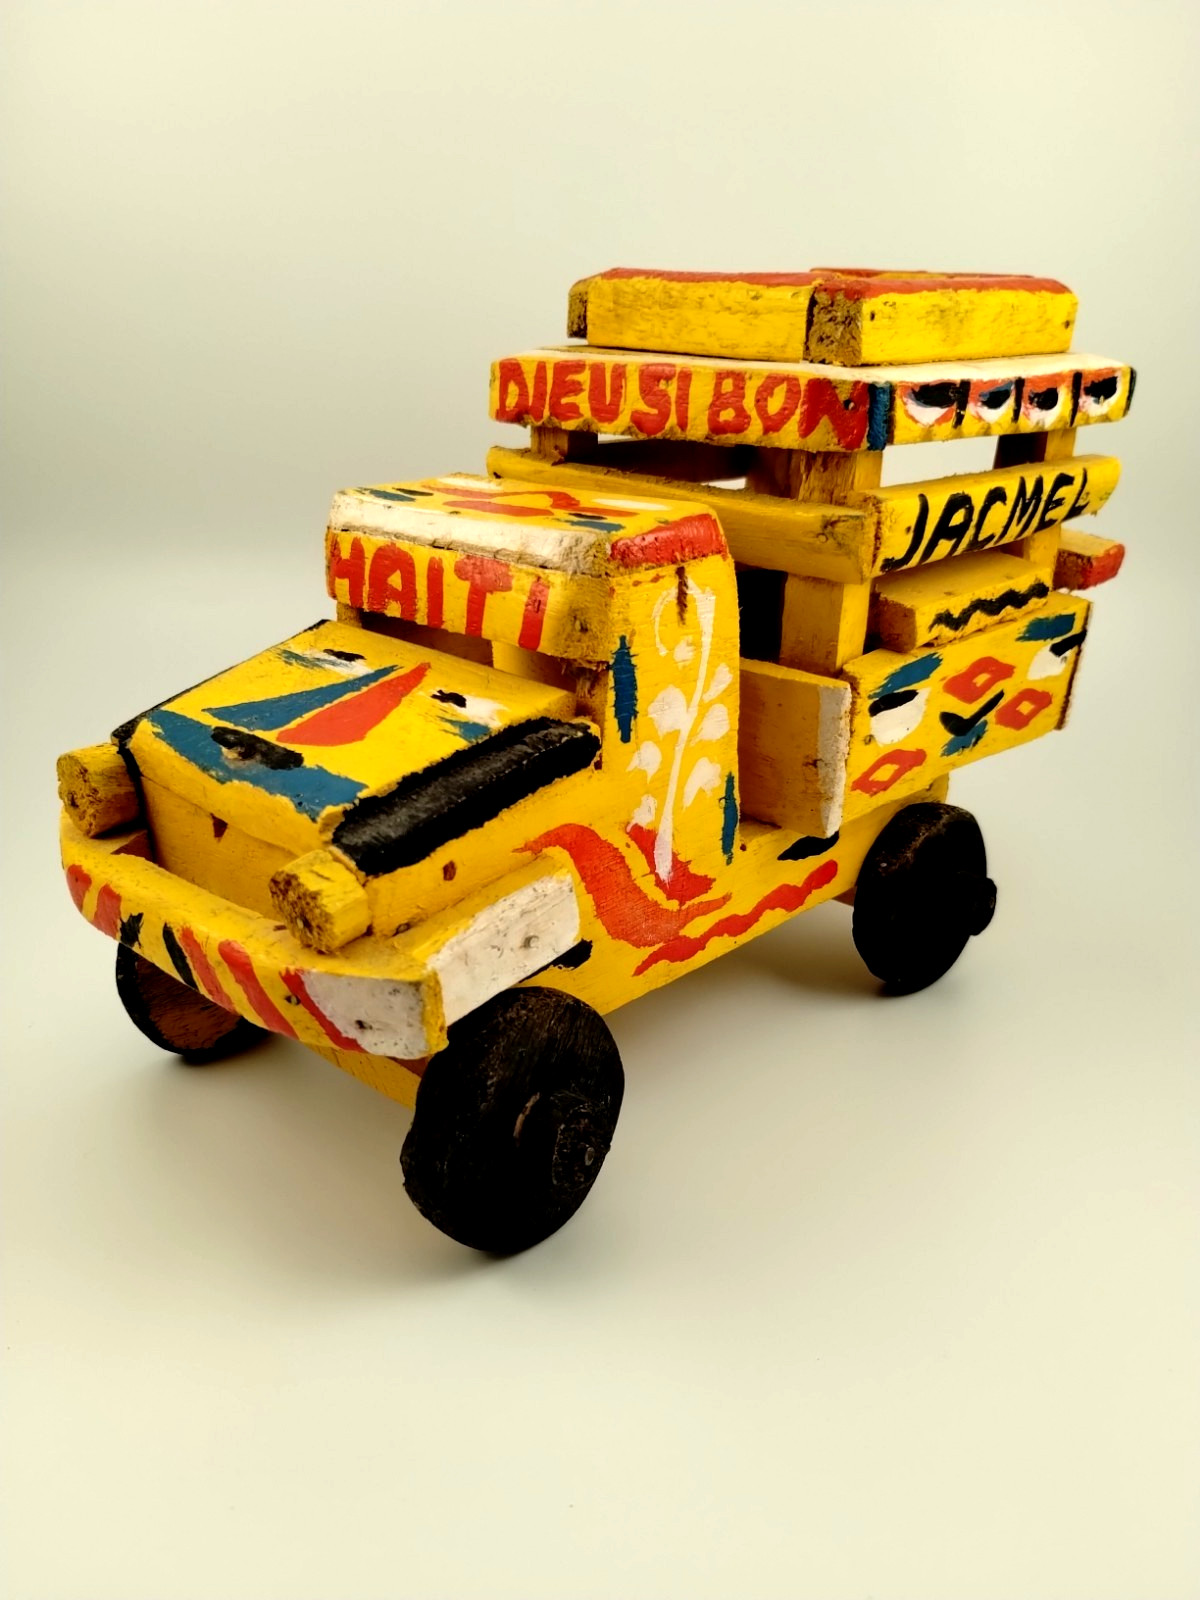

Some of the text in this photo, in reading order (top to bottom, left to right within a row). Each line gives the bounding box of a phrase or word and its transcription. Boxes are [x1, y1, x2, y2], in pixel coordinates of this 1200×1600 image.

[707, 370, 870, 451] BON
[880, 467, 1090, 573] JACMEL
[328, 536, 550, 652] HAITI
